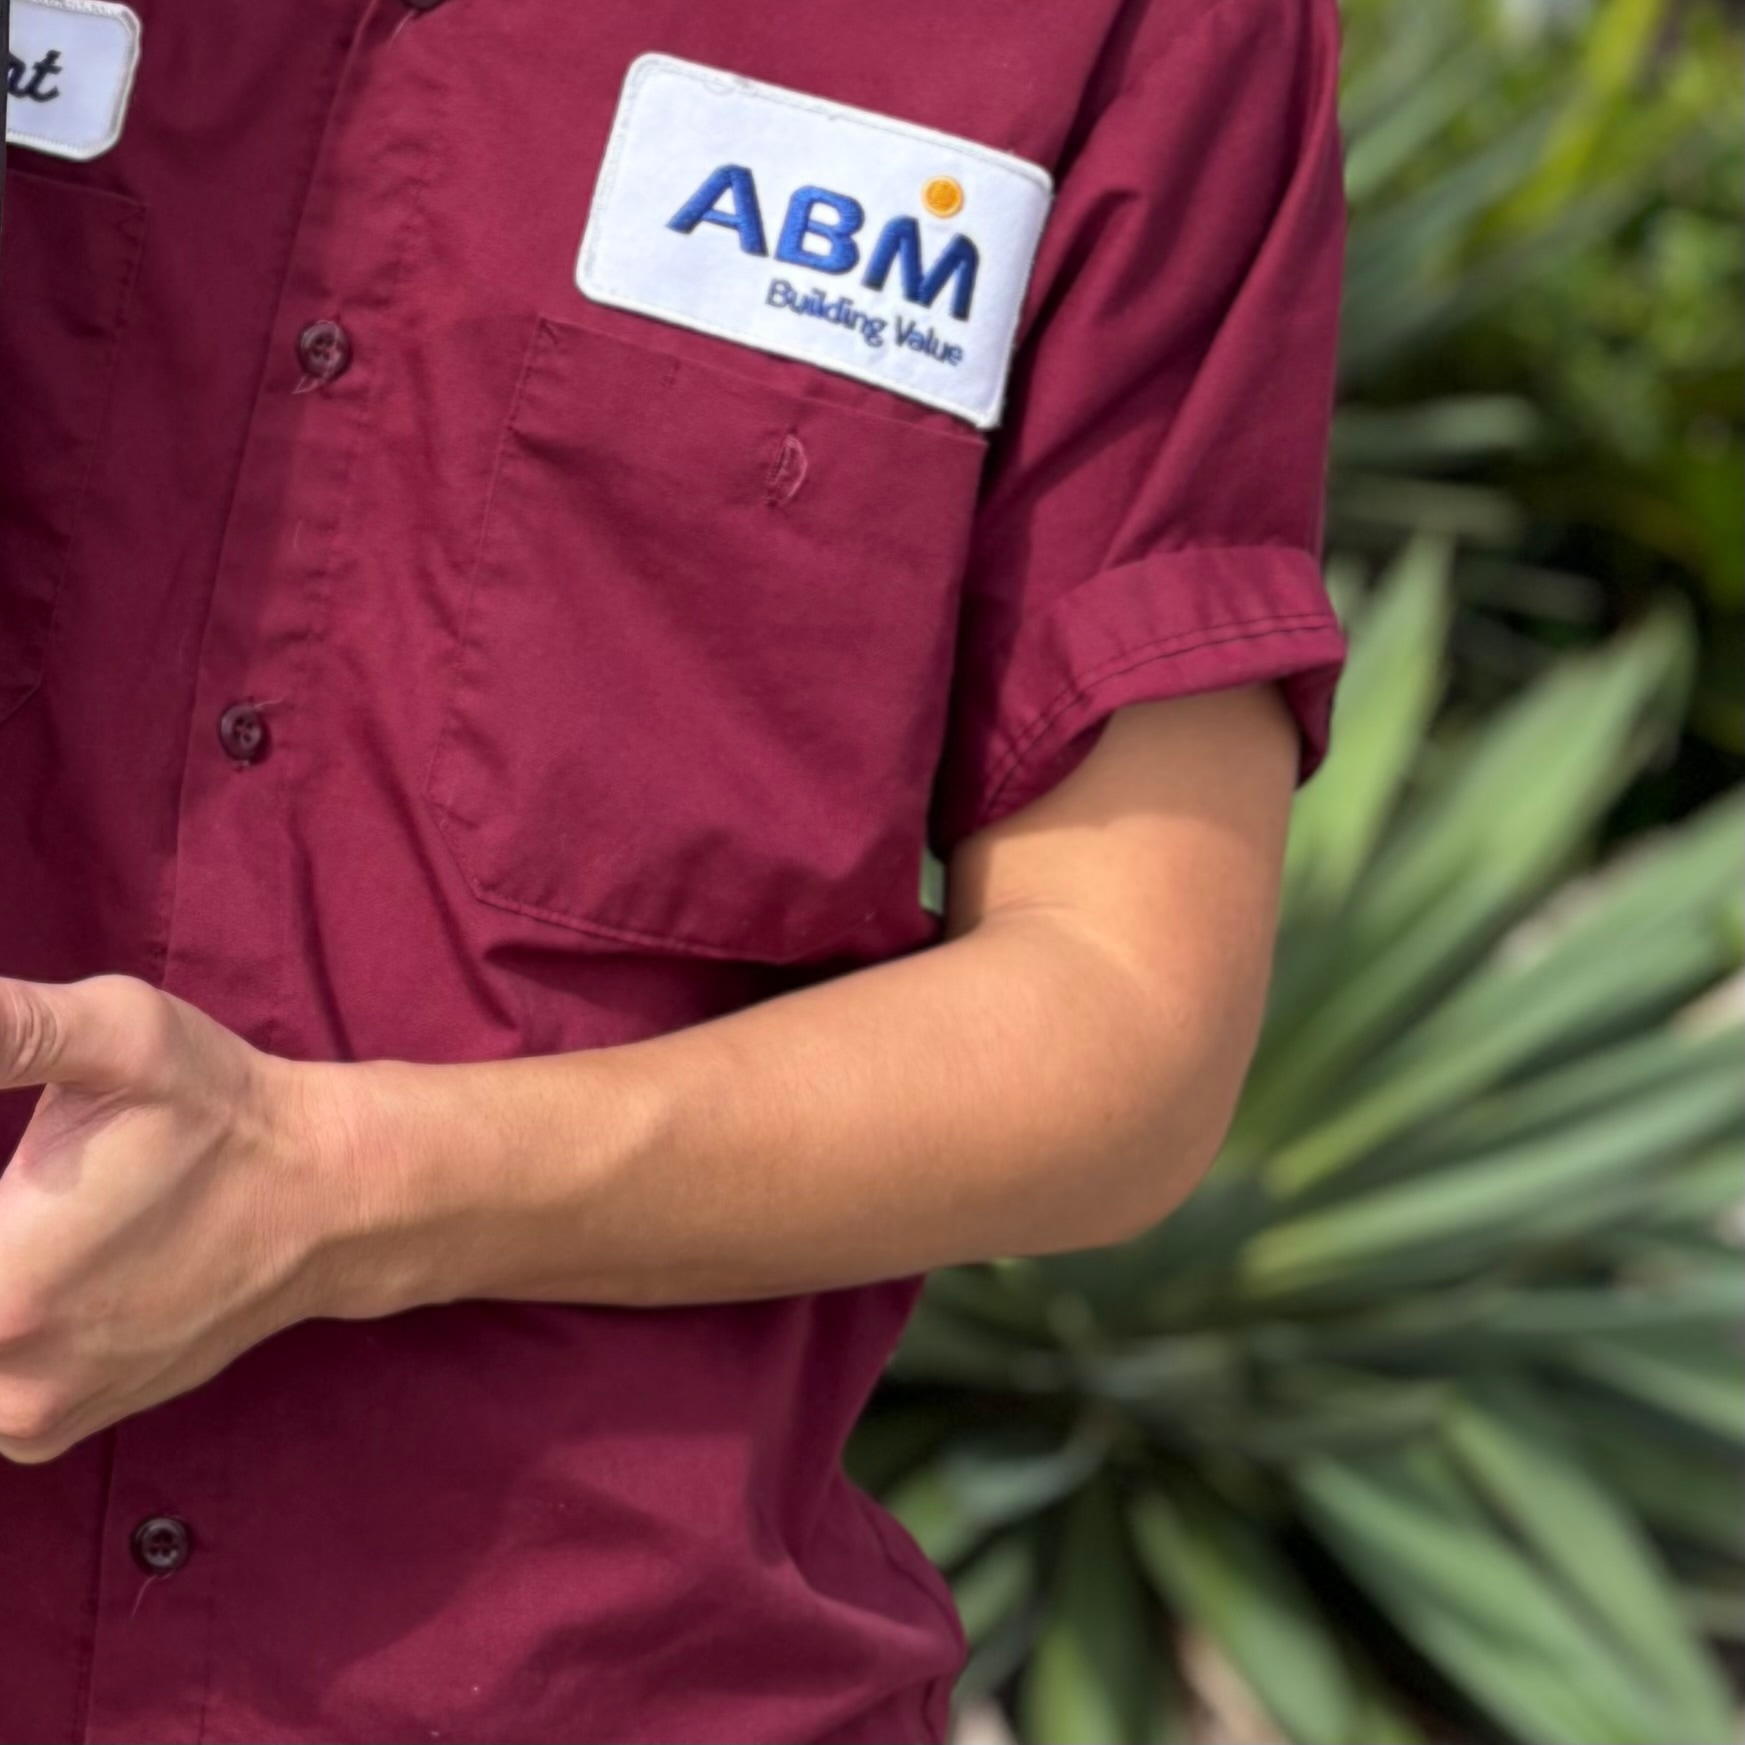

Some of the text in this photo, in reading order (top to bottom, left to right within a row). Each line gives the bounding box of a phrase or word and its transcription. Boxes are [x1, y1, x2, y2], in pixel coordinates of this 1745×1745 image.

[666, 164, 980, 321] ABM
[765, 278, 963, 366] Building Value
